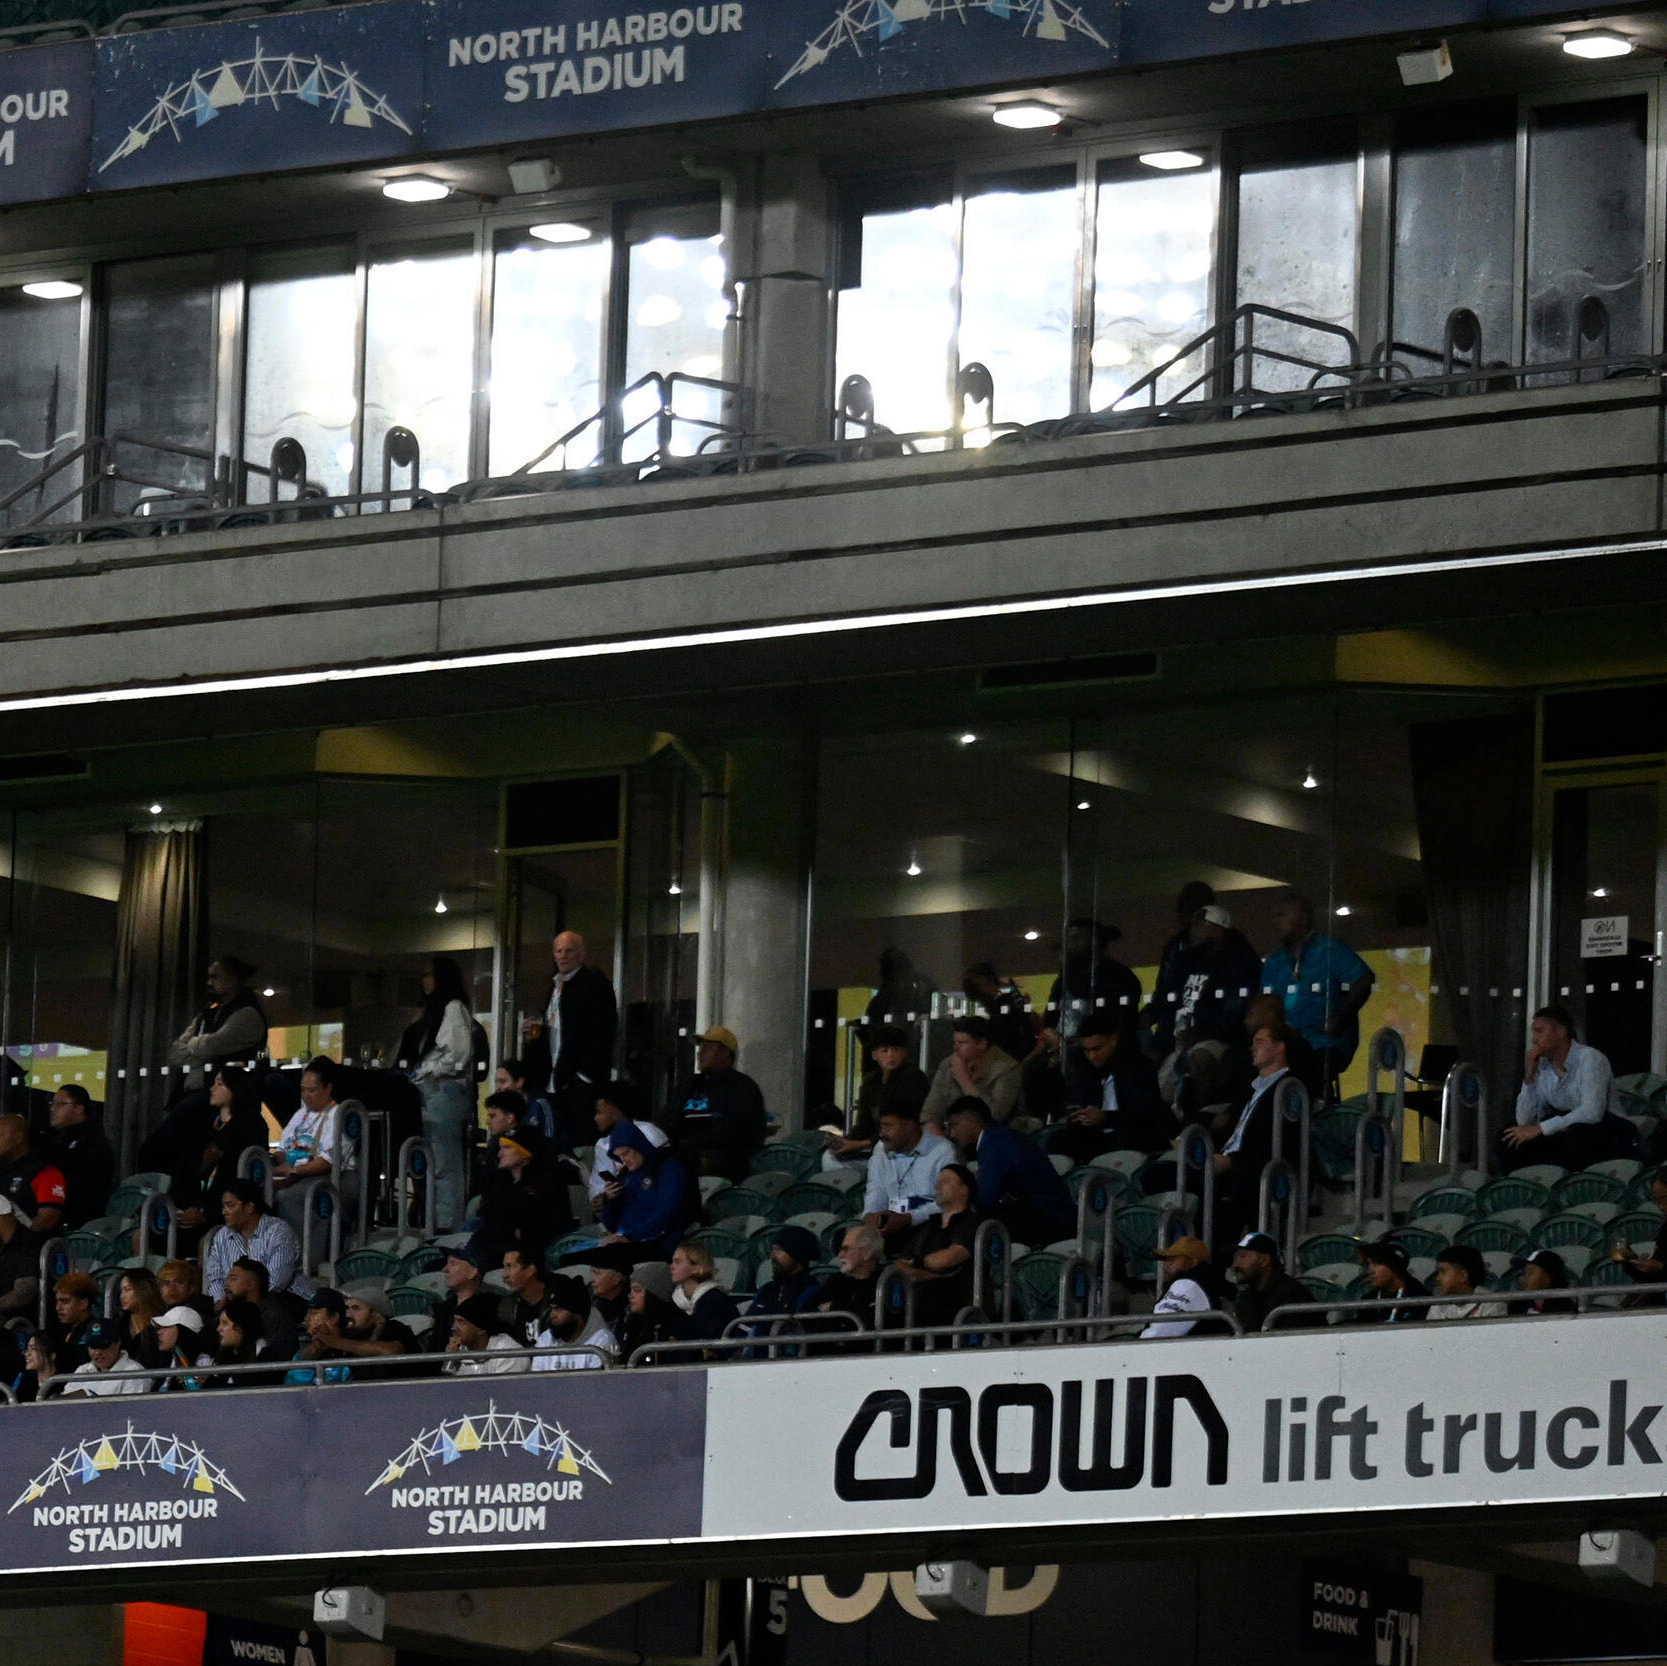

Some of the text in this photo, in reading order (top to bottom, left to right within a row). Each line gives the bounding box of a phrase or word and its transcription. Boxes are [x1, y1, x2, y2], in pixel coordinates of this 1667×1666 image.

[449, 3, 742, 67] NORTH HARBOUR
[504, 46, 684, 102] STADIUM
[835, 1374, 1228, 1501] CROWN
[1263, 1395, 1378, 1483] lift
[392, 1481, 583, 1507] NORTH HARBOUR
[34, 1499, 217, 1526] NORTH HARBOUR
[428, 1506, 545, 1535] STADIUM
[69, 1524, 182, 1552] STADIUM
[1314, 1581, 1356, 1605] FOOD
[1313, 1610, 1359, 1635] DRINK
[230, 1640, 285, 1665] WOMEN
